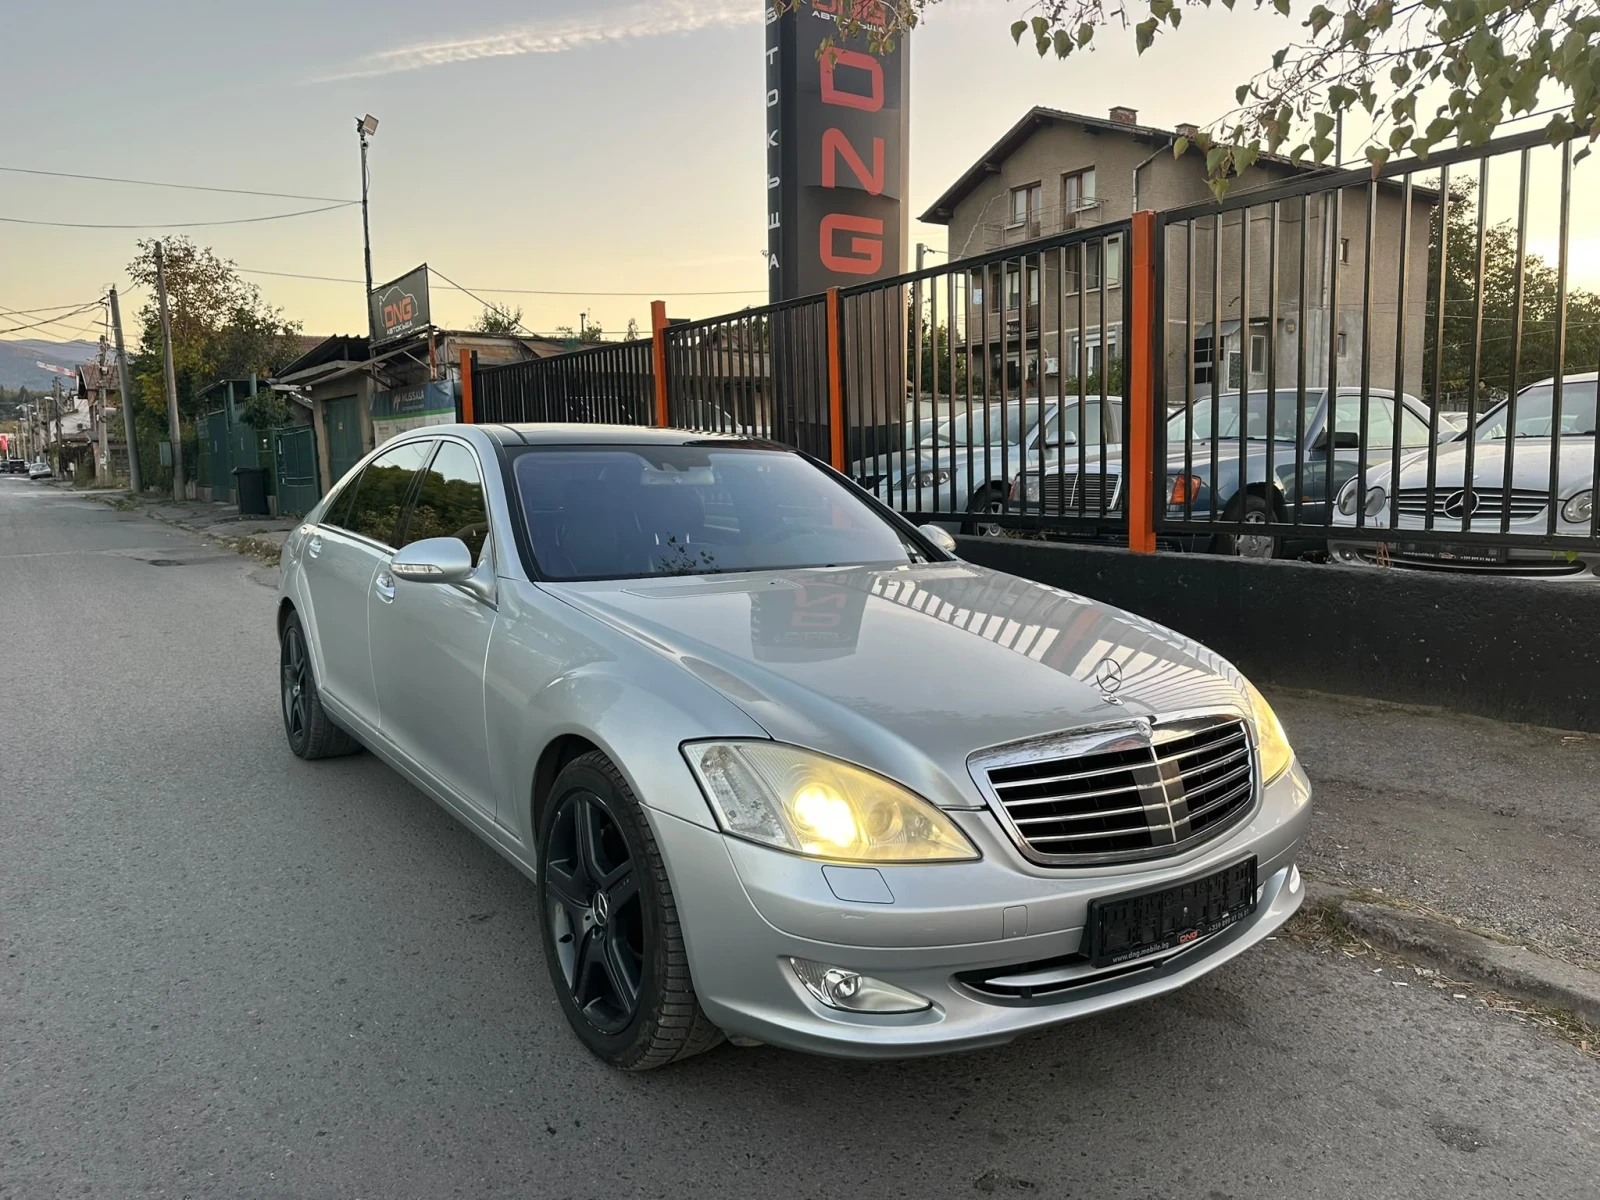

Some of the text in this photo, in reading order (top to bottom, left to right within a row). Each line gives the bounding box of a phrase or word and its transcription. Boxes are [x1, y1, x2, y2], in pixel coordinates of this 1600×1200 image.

[820, 46, 885, 275] DNG
[384, 296, 412, 329] DNG
[1179, 931, 1198, 944] DNG
[1113, 941, 1170, 963] www.dng.mobile.bg
